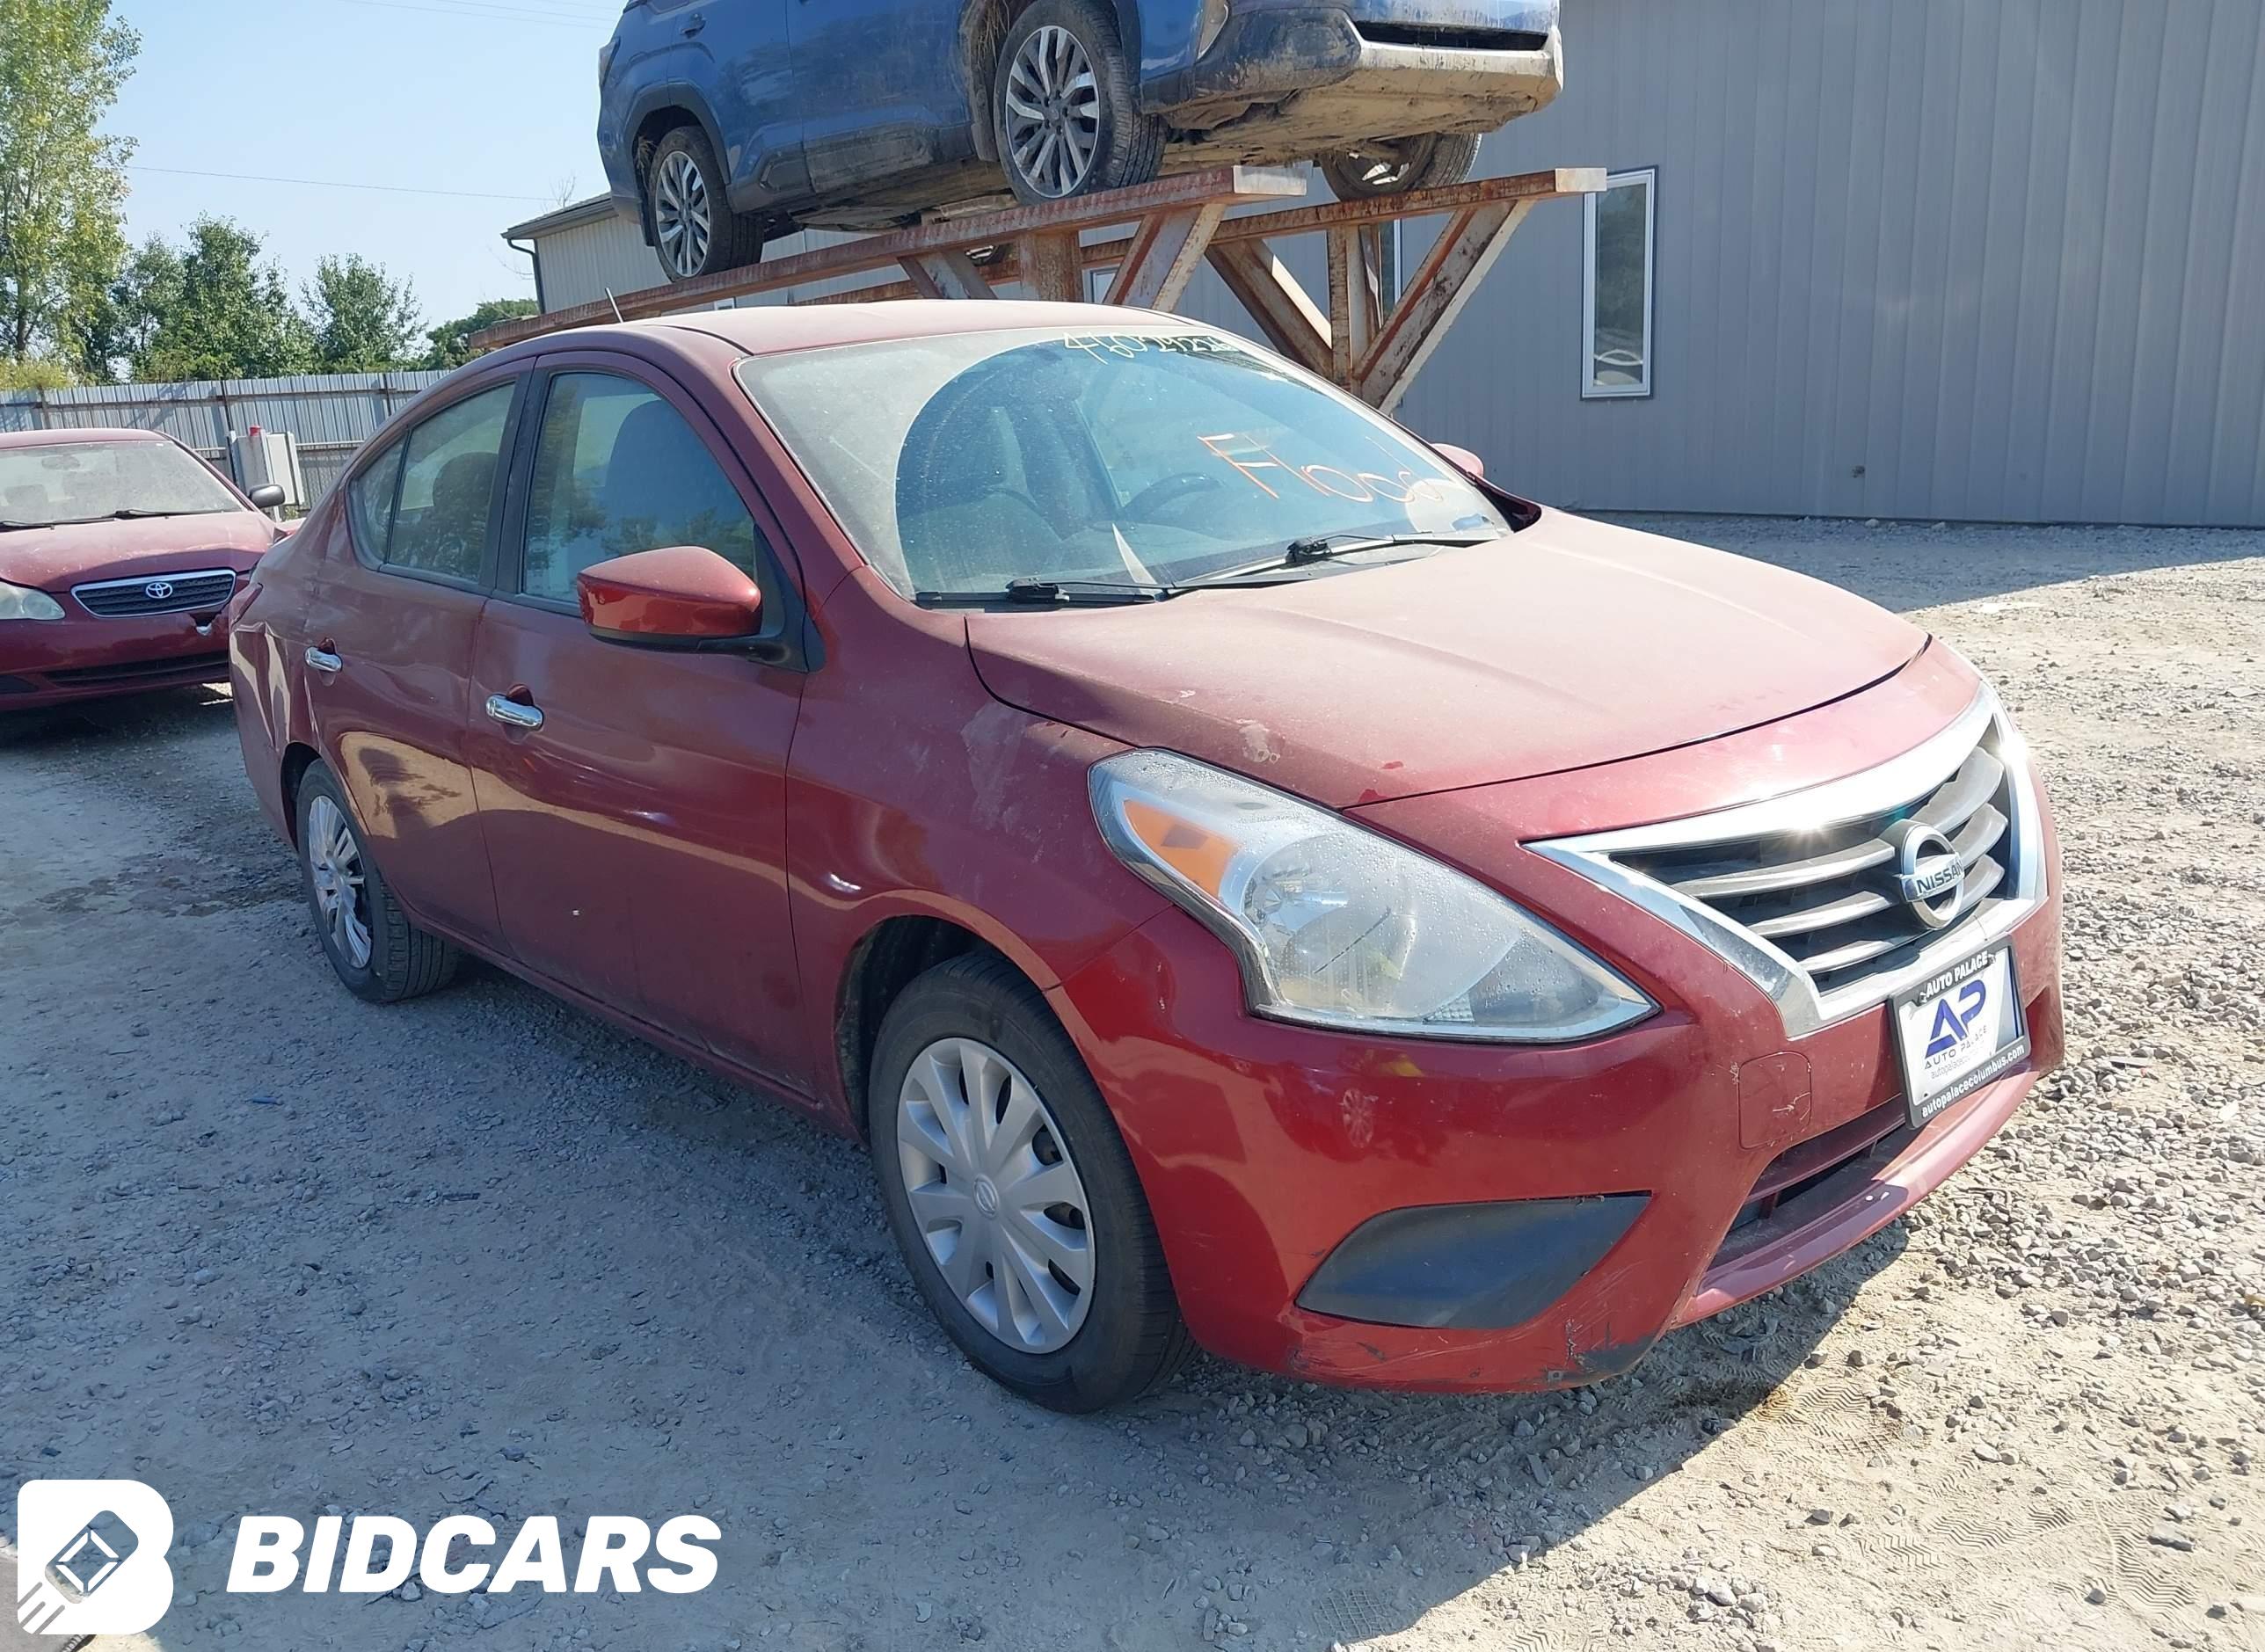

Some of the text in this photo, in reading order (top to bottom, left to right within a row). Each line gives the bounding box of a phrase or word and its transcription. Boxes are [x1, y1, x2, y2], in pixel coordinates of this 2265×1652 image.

[1916, 859, 1963, 894] NISSAN
[1926, 950, 1988, 999] AUTO PALACE
[1925, 979, 1986, 1059] AP
[1921, 1044, 2025, 1117] autopalacecolumbus.com
[1925, 1048, 1956, 1070] AUTO
